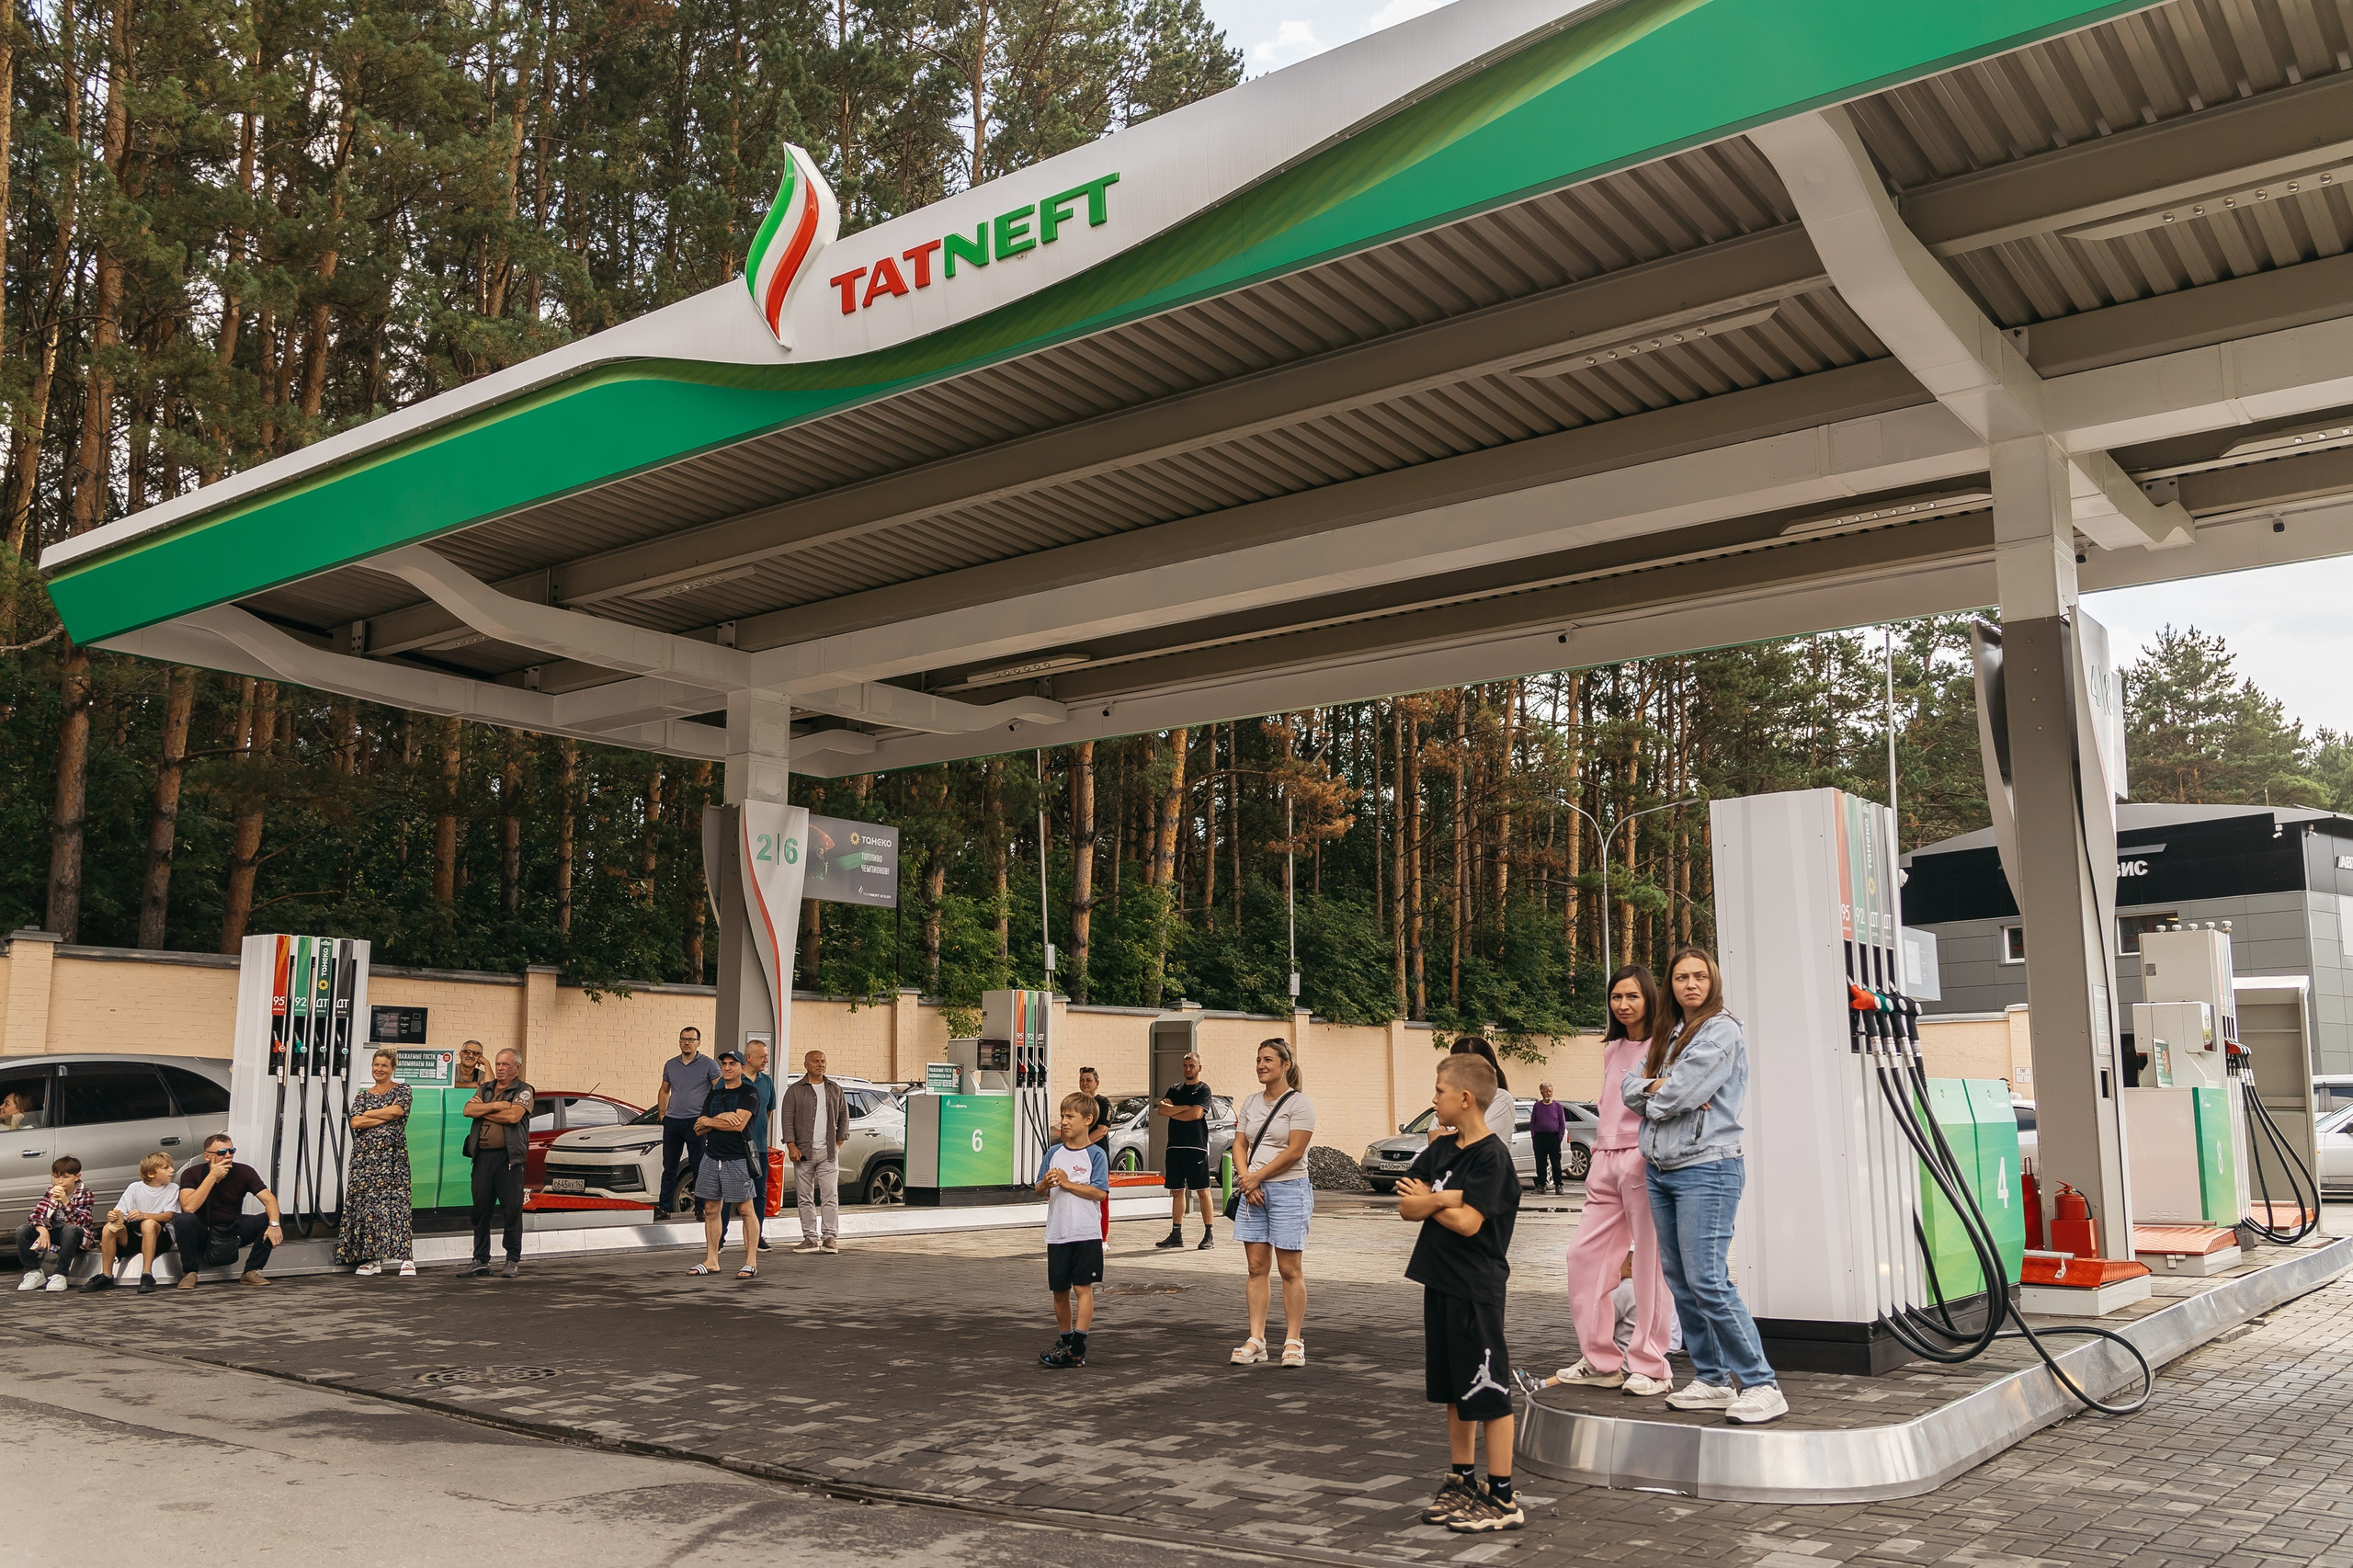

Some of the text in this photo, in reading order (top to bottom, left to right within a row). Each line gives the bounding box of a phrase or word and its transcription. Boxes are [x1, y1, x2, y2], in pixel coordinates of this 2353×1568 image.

[829, 171, 1120, 315] TATNEFT
[861, 835, 892, 847] ТАНЕКО
[860, 852, 883, 863] ТОПЛИВО
[861, 864, 890, 875] ЧЕМПИОНОВ!
[1840, 903, 1850, 922] 95
[1856, 906, 1866, 925] 92
[1870, 911, 1879, 928] ДТ
[1883, 914, 1893, 930] ДТ
[273, 995, 286, 1006] 95
[294, 996, 307, 1006] 92
[315, 998, 329, 1008] ДТ
[336, 999, 349, 1008] ДТ
[971, 1129, 983, 1152] 6
[2216, 1140, 2223, 1176] 8
[1997, 1156, 2009, 1209] 4
